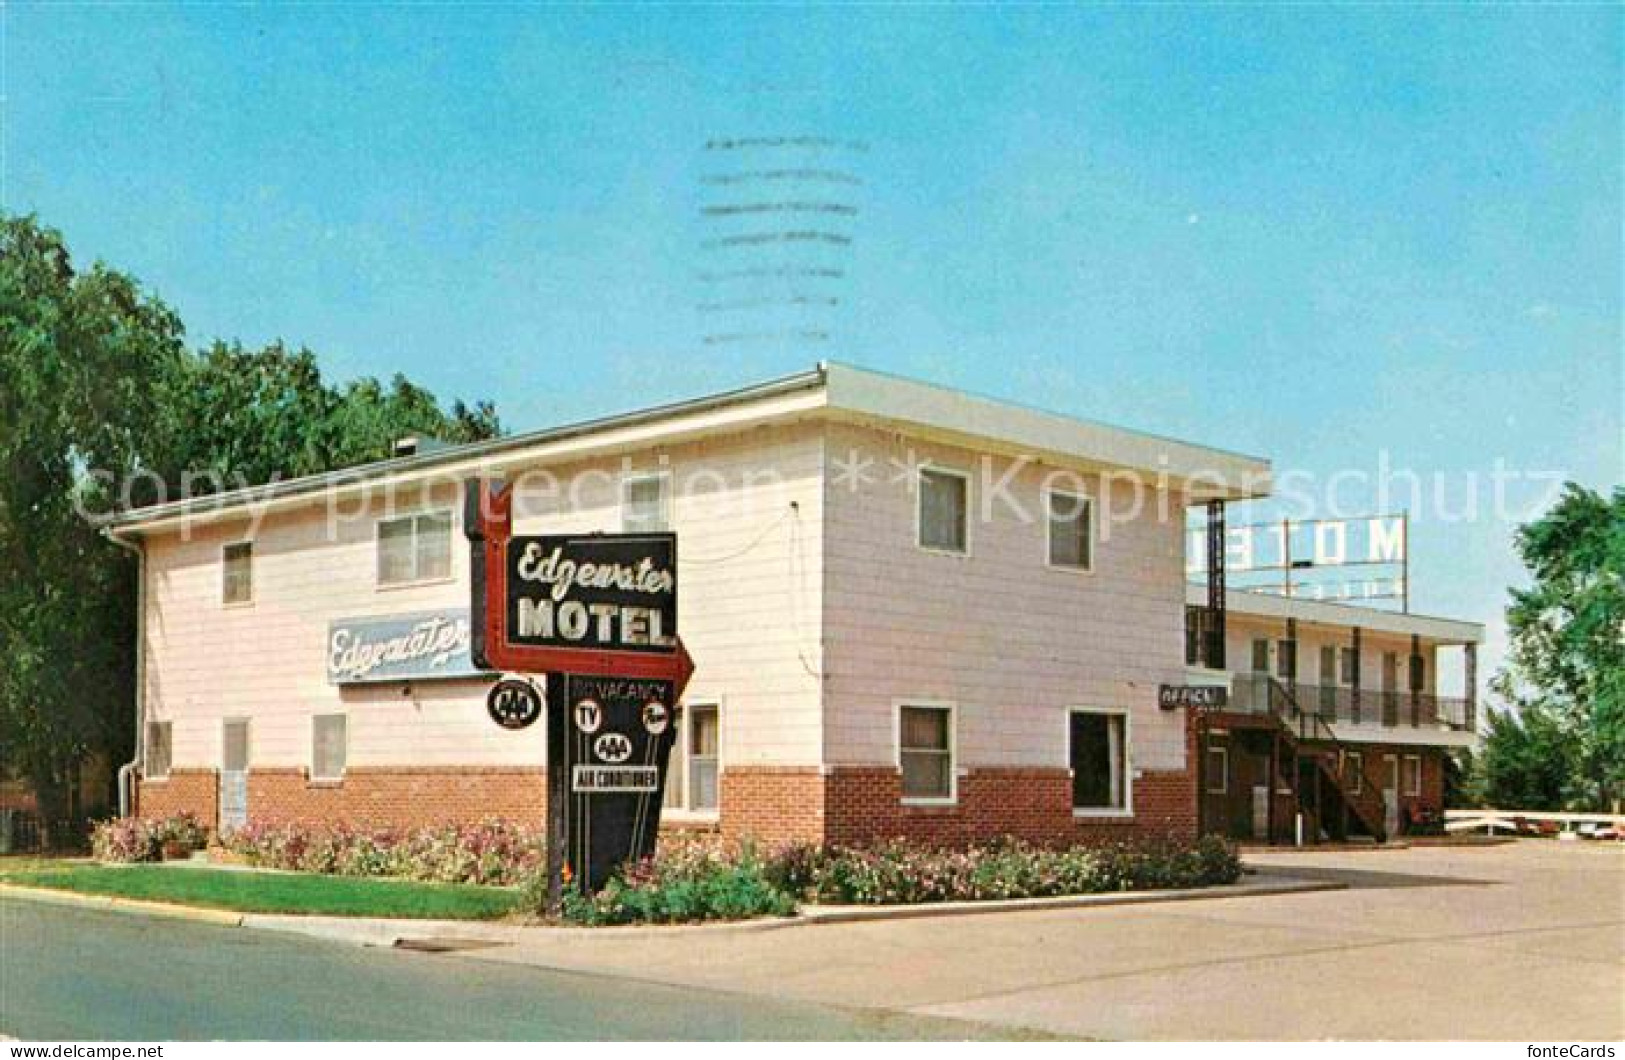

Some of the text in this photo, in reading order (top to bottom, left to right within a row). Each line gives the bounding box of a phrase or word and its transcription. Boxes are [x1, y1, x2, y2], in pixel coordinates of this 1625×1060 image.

[518, 541, 675, 601] Edgewater
[518, 597, 677, 645] MOTEL
[600, 681, 667, 700] VACANCY
[493, 688, 535, 720] AAA
[579, 706, 596, 726] TV
[598, 737, 629, 759] AAA
[577, 770, 595, 787] AIR
